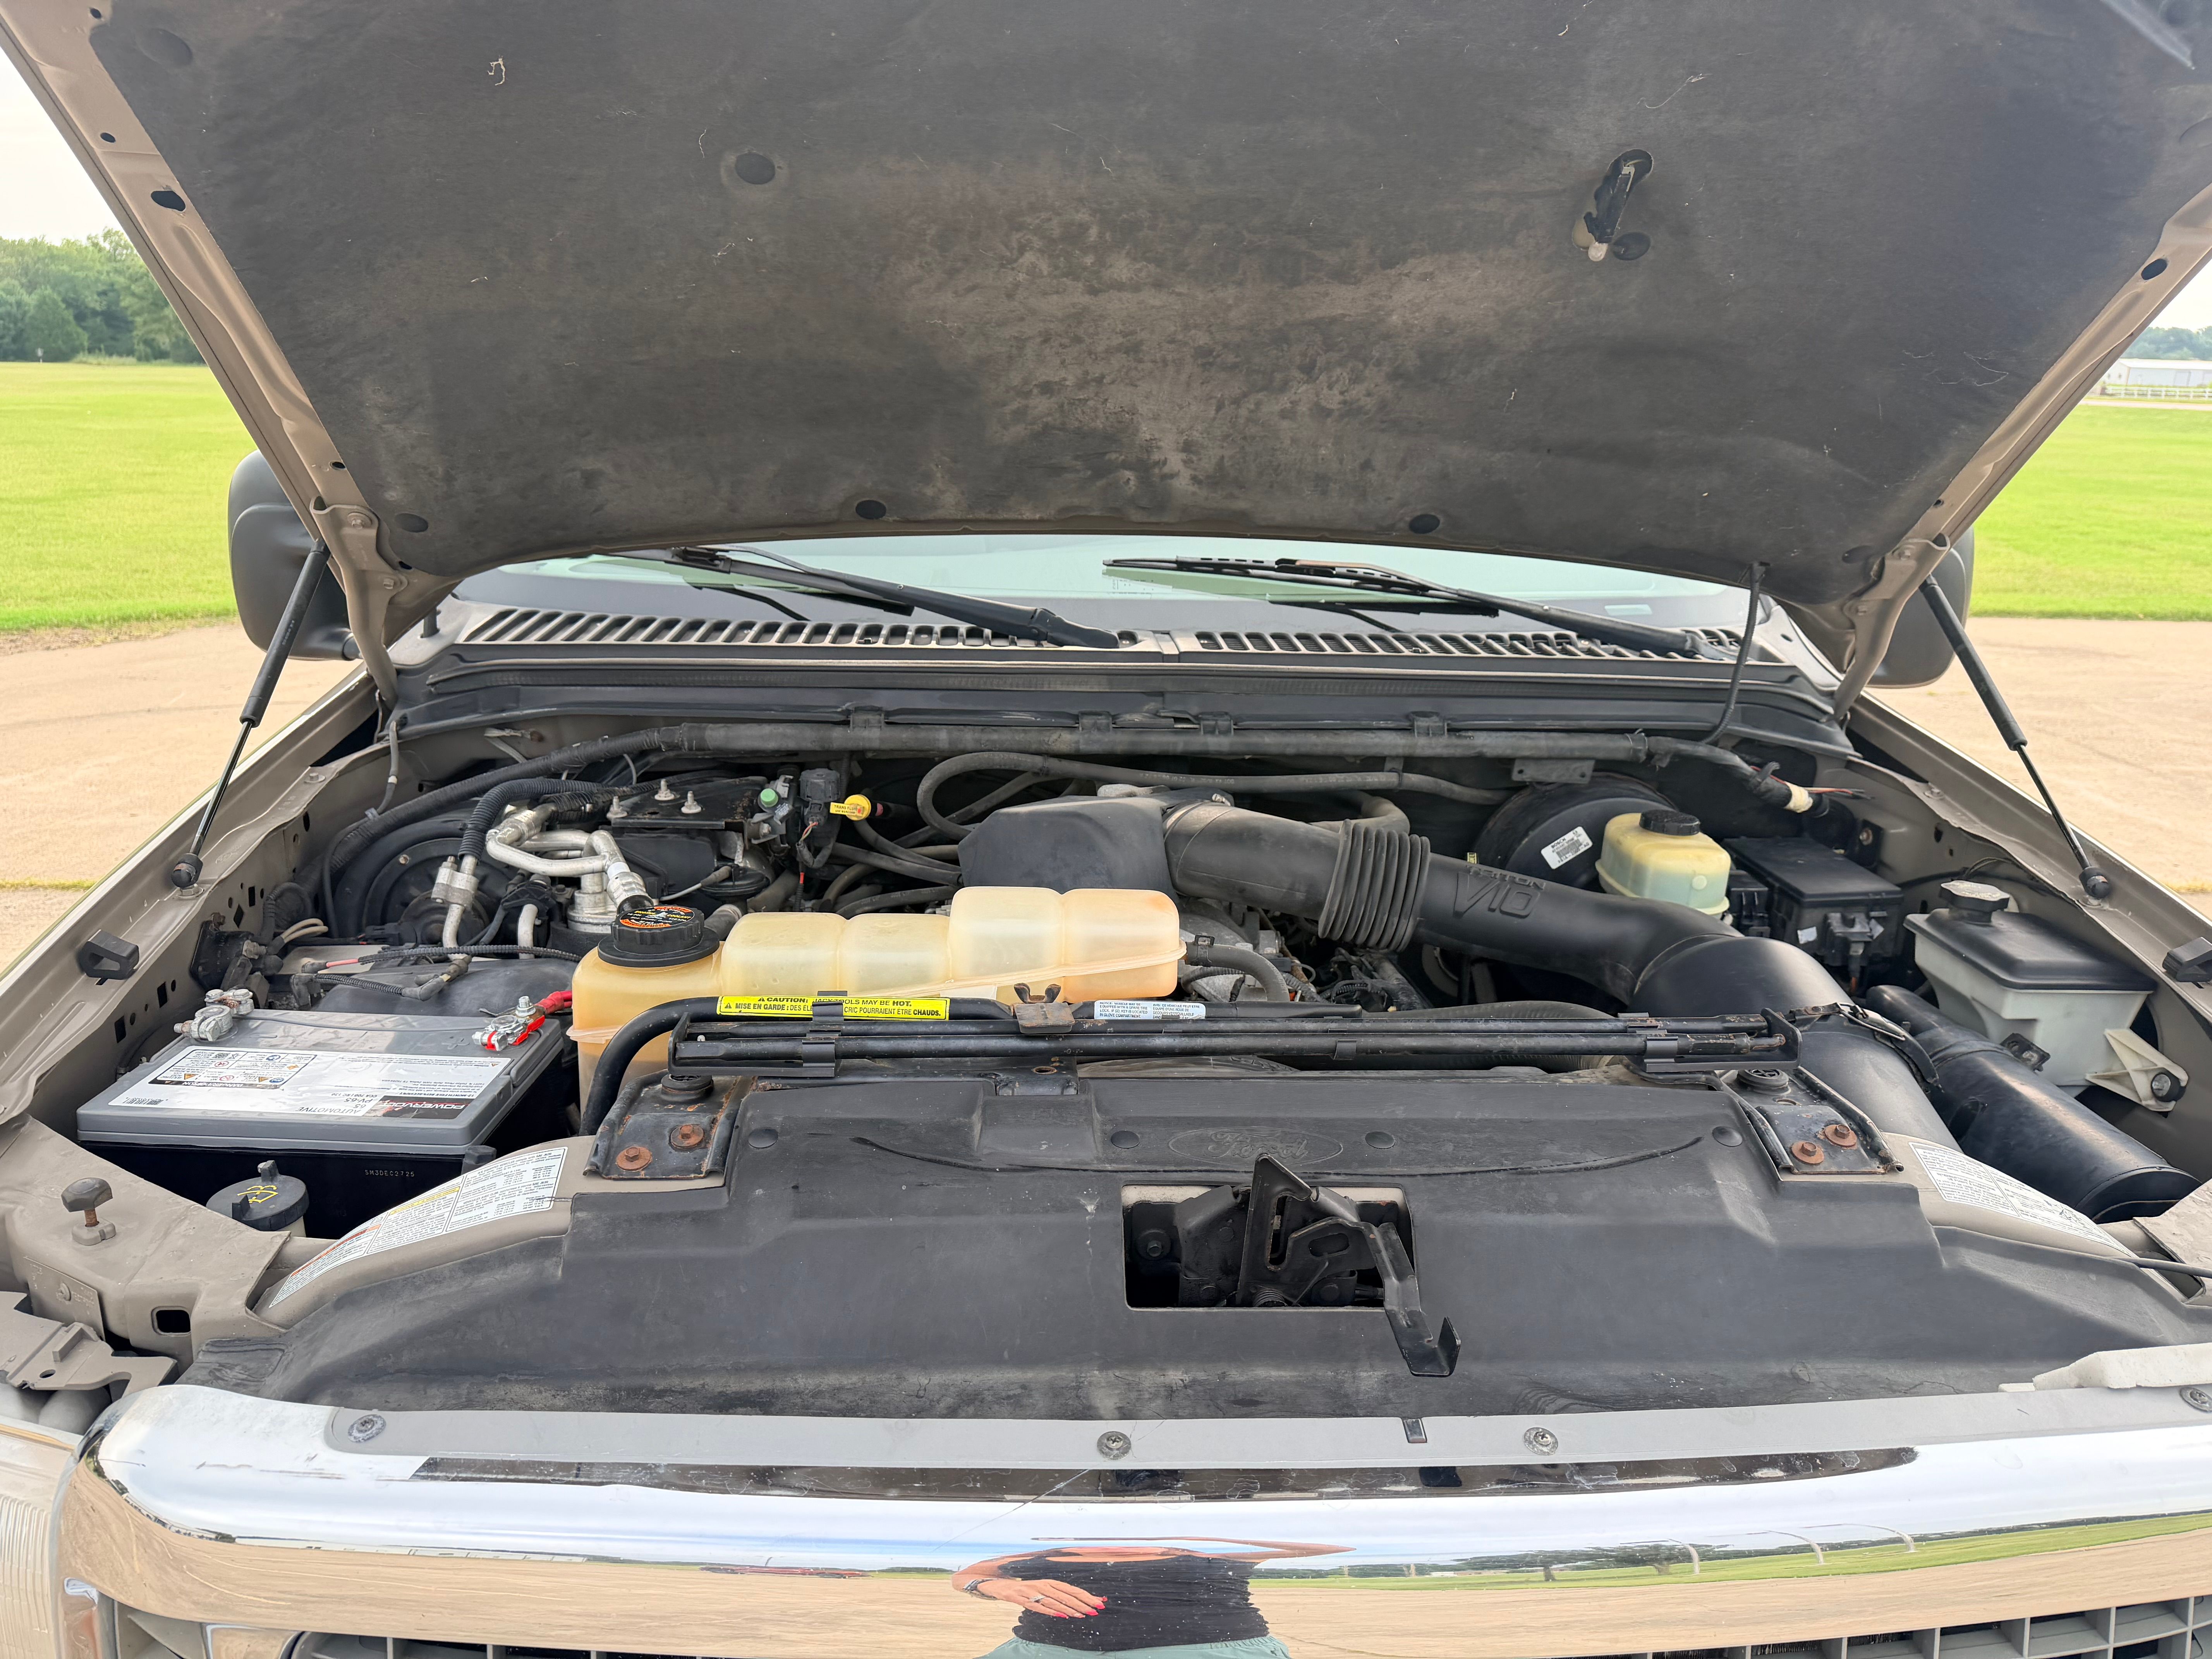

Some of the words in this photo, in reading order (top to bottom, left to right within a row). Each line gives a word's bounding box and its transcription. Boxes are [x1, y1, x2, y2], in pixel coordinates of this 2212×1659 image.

[1466, 865, 1546, 890] TRITON
[1453, 872, 1540, 919] V10
[1203, 1130, 1309, 1159] Ford
